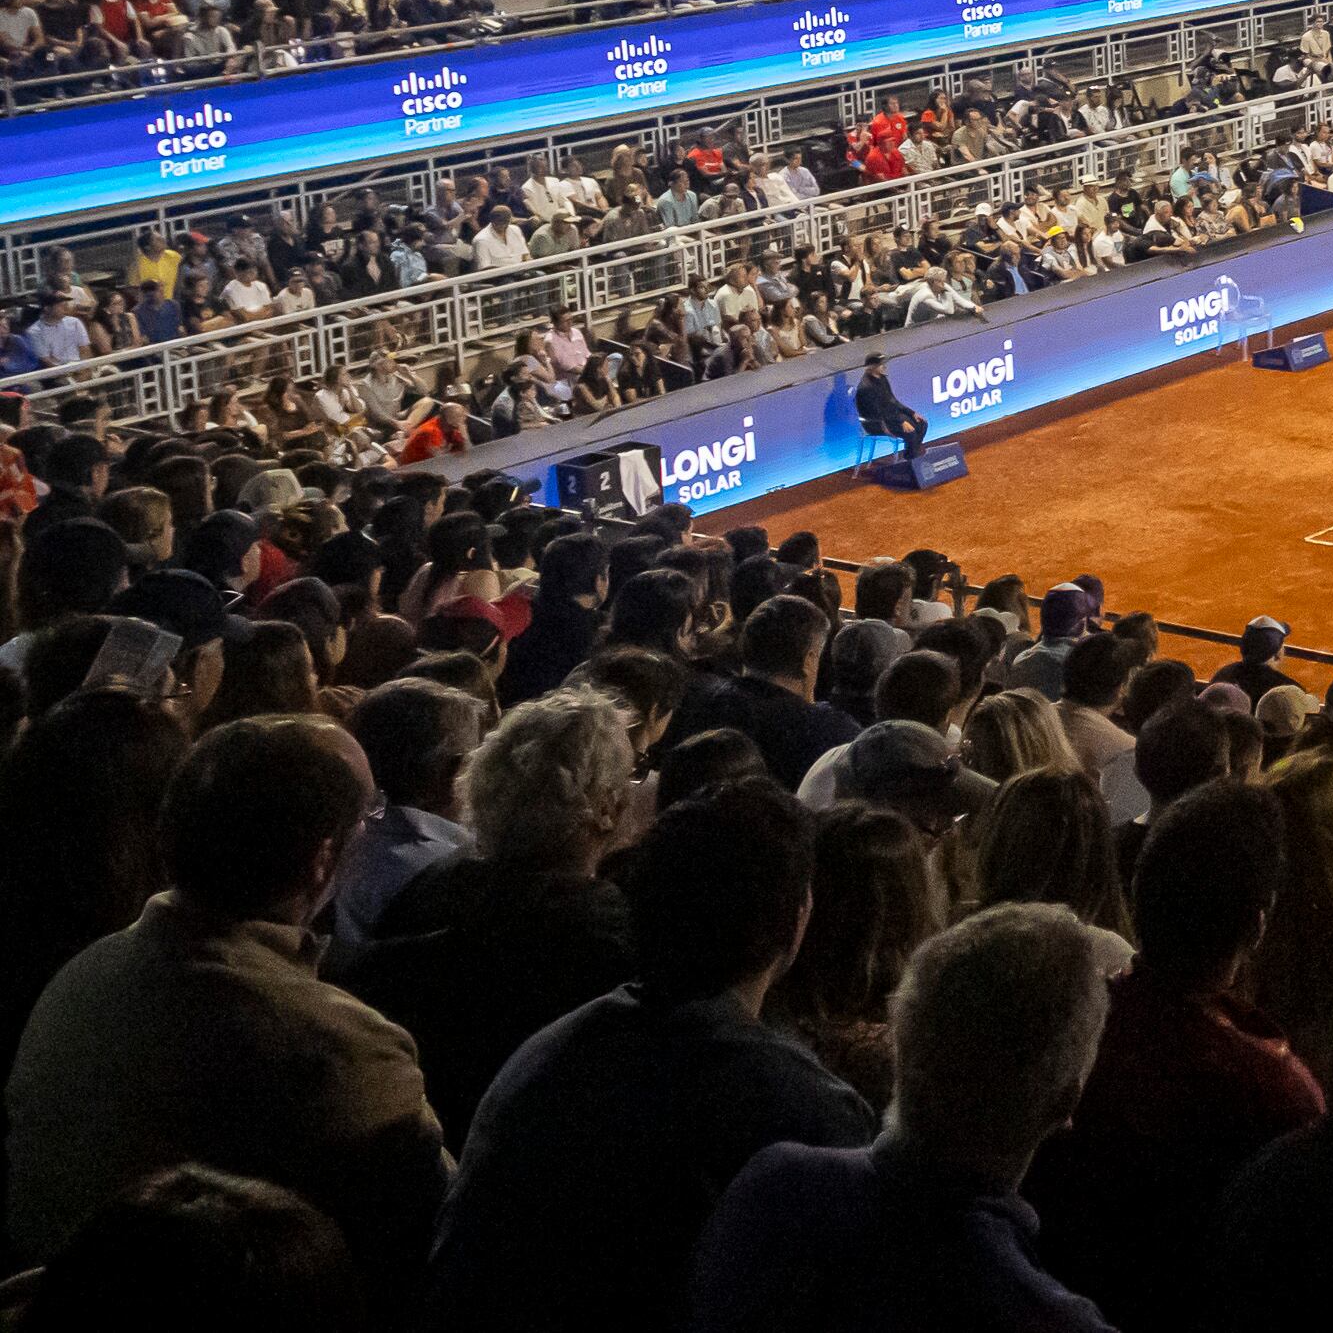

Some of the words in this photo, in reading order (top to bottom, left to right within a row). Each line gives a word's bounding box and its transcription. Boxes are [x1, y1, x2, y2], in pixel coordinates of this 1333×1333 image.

[962, 4, 1003, 22] CISCO
[800, 29, 846, 49] CISCO
[964, 21, 1003, 39] Partner
[802, 48, 846, 66] Partner
[615, 58, 668, 80] CISCO
[617, 79, 668, 99] Partner
[402, 92, 463, 116] CISCO
[404, 115, 463, 136] Partner
[157, 130, 227, 157] CISCO
[159, 154, 227, 179] Partner
[1174, 319, 1219, 346] SOLAR
[950, 389, 1003, 418] SOLAR
[600, 471, 612, 491] 2
[679, 470, 742, 504] SOLAR
